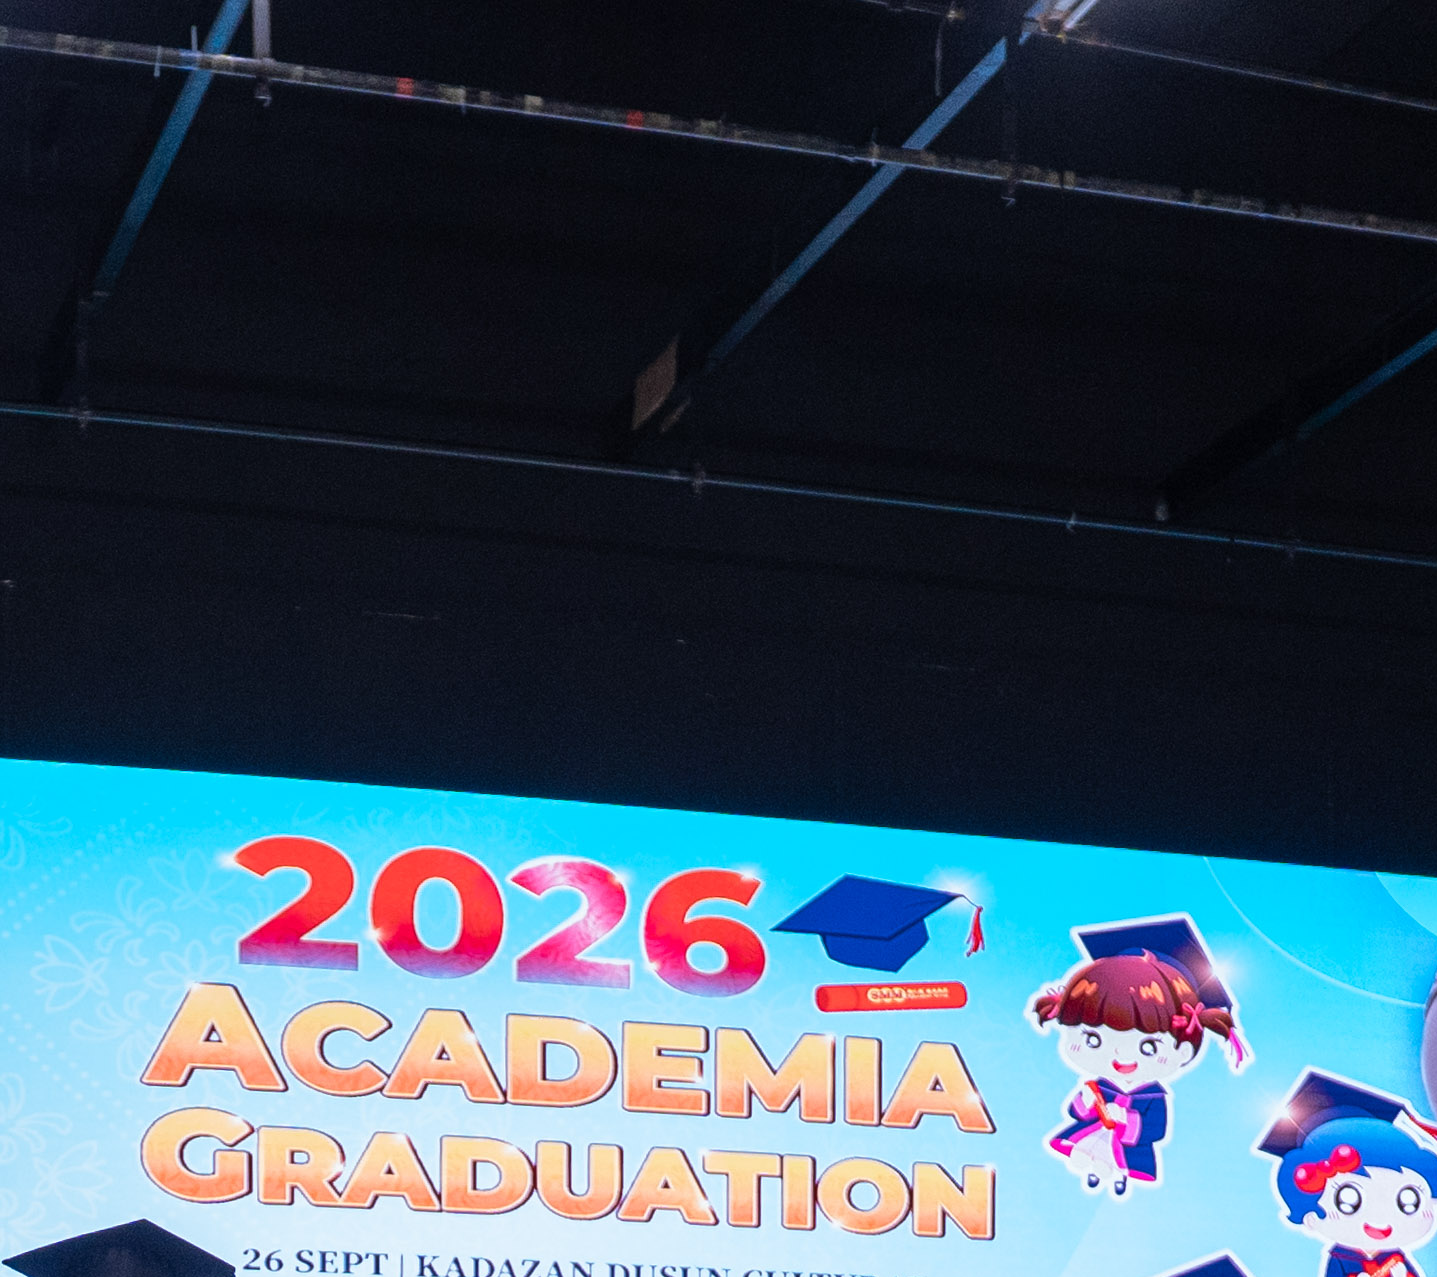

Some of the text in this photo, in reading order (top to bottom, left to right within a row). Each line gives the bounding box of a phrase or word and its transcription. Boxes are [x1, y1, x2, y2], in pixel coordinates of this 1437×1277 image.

[232, 834, 768, 998] 2026
[140, 982, 996, 1135] ACADEMIA
[140, 1106, 996, 1240] GRADUATION
[242, 1248, 389, 1276] 26 SEPT
